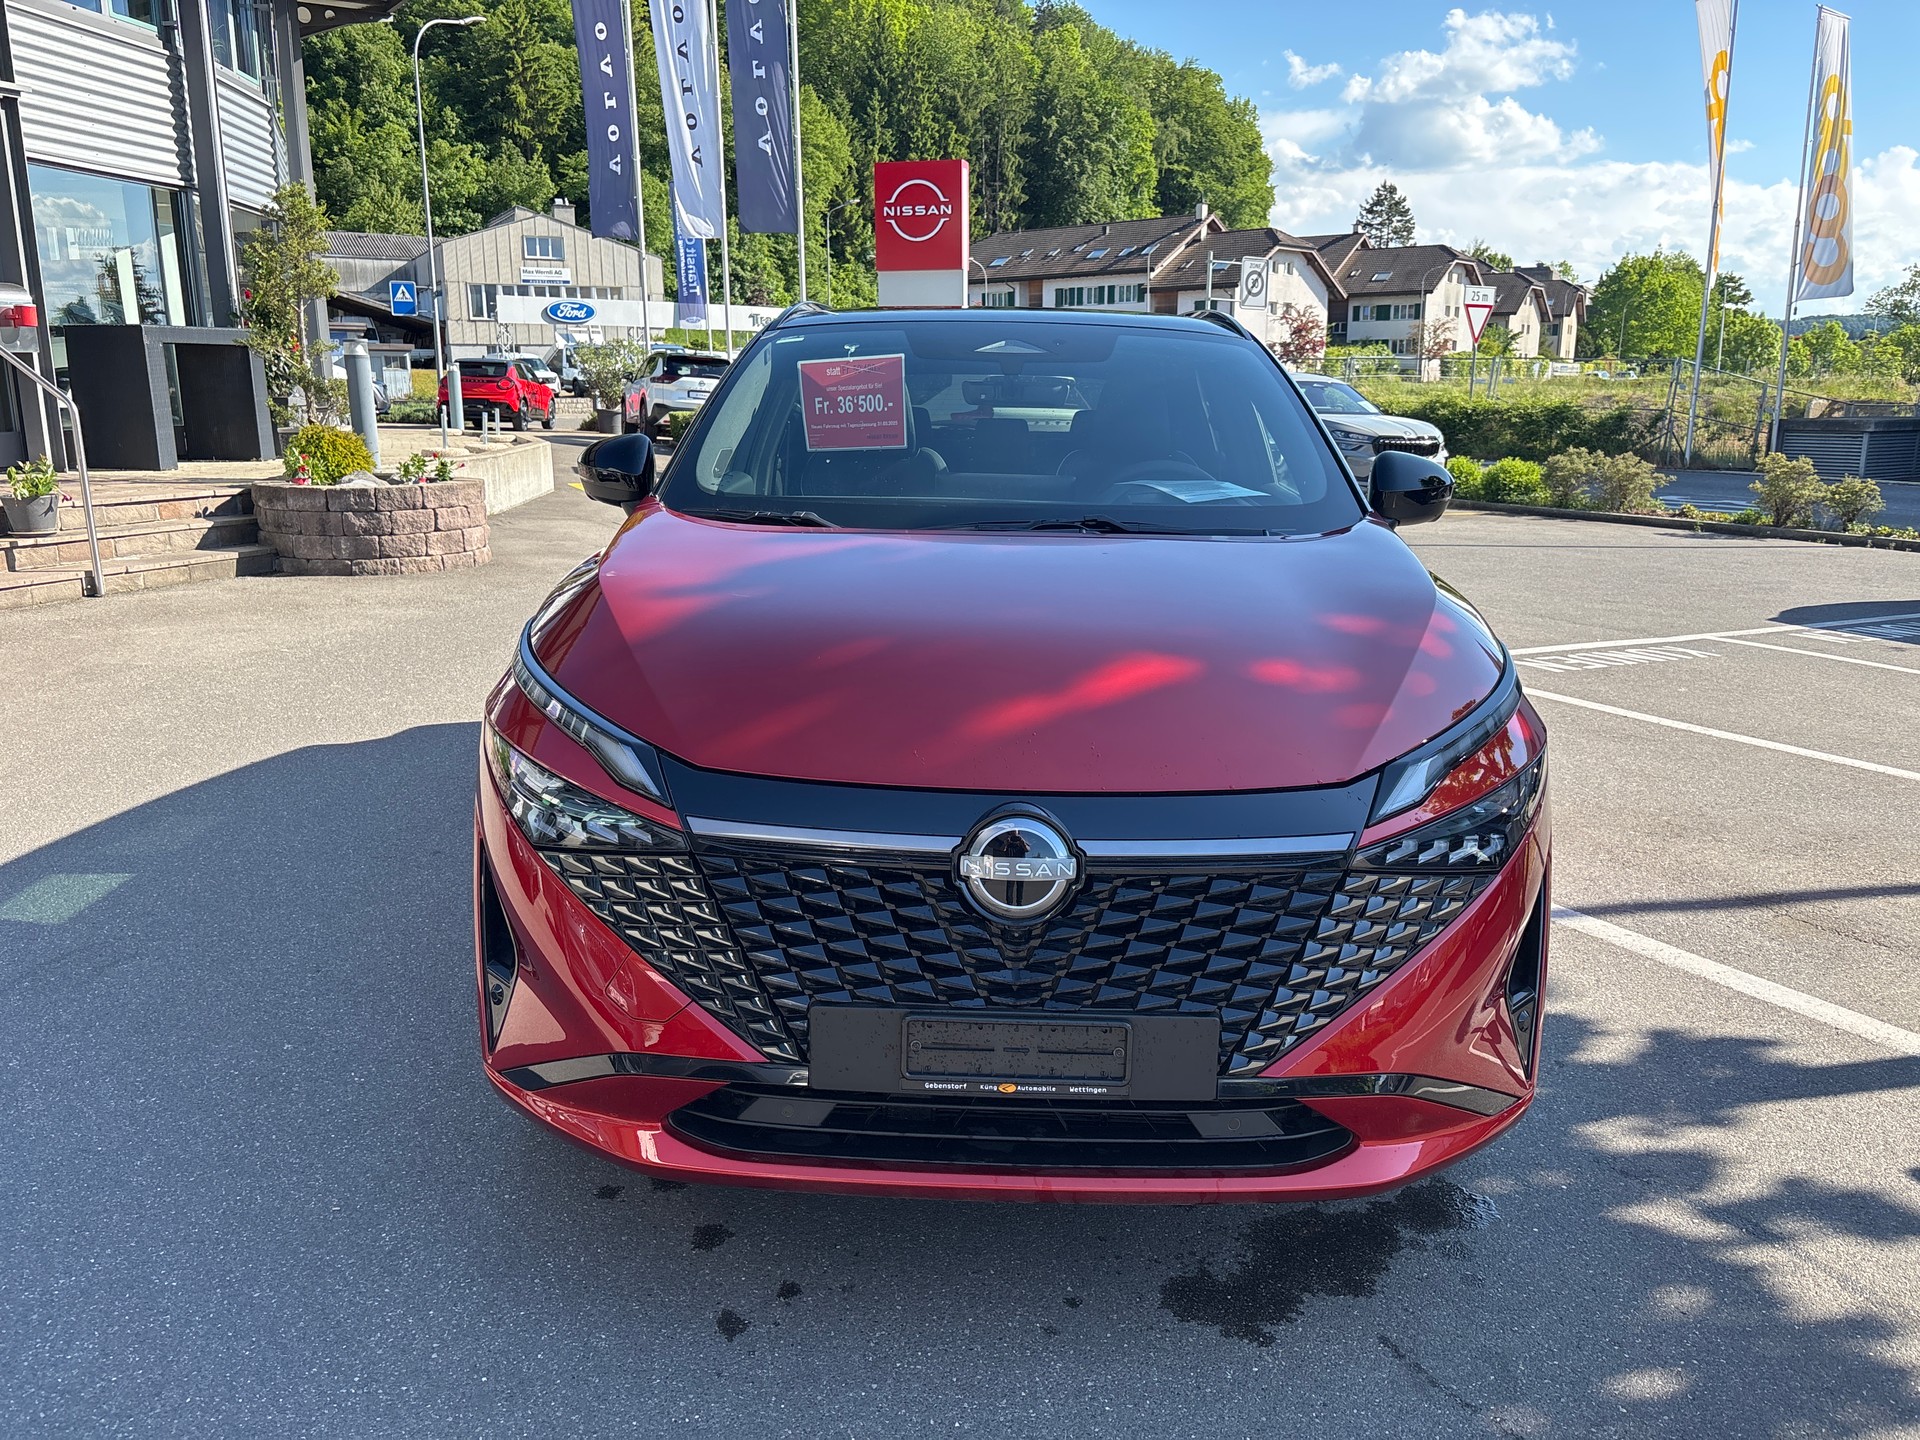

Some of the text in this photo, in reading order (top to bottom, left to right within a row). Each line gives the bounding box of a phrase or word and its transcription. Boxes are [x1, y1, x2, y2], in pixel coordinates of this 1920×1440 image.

[883, 204, 952, 217] NISSAN
[1471, 291, 1488, 302] 25 m
[557, 303, 587, 318] Ford
[826, 367, 841, 376] statt
[815, 397, 833, 415] Fr.
[963, 860, 1074, 877] NISSAN
[924, 1082, 968, 1090] Gebenstorf
[1069, 1086, 1107, 1094] Wettingen
